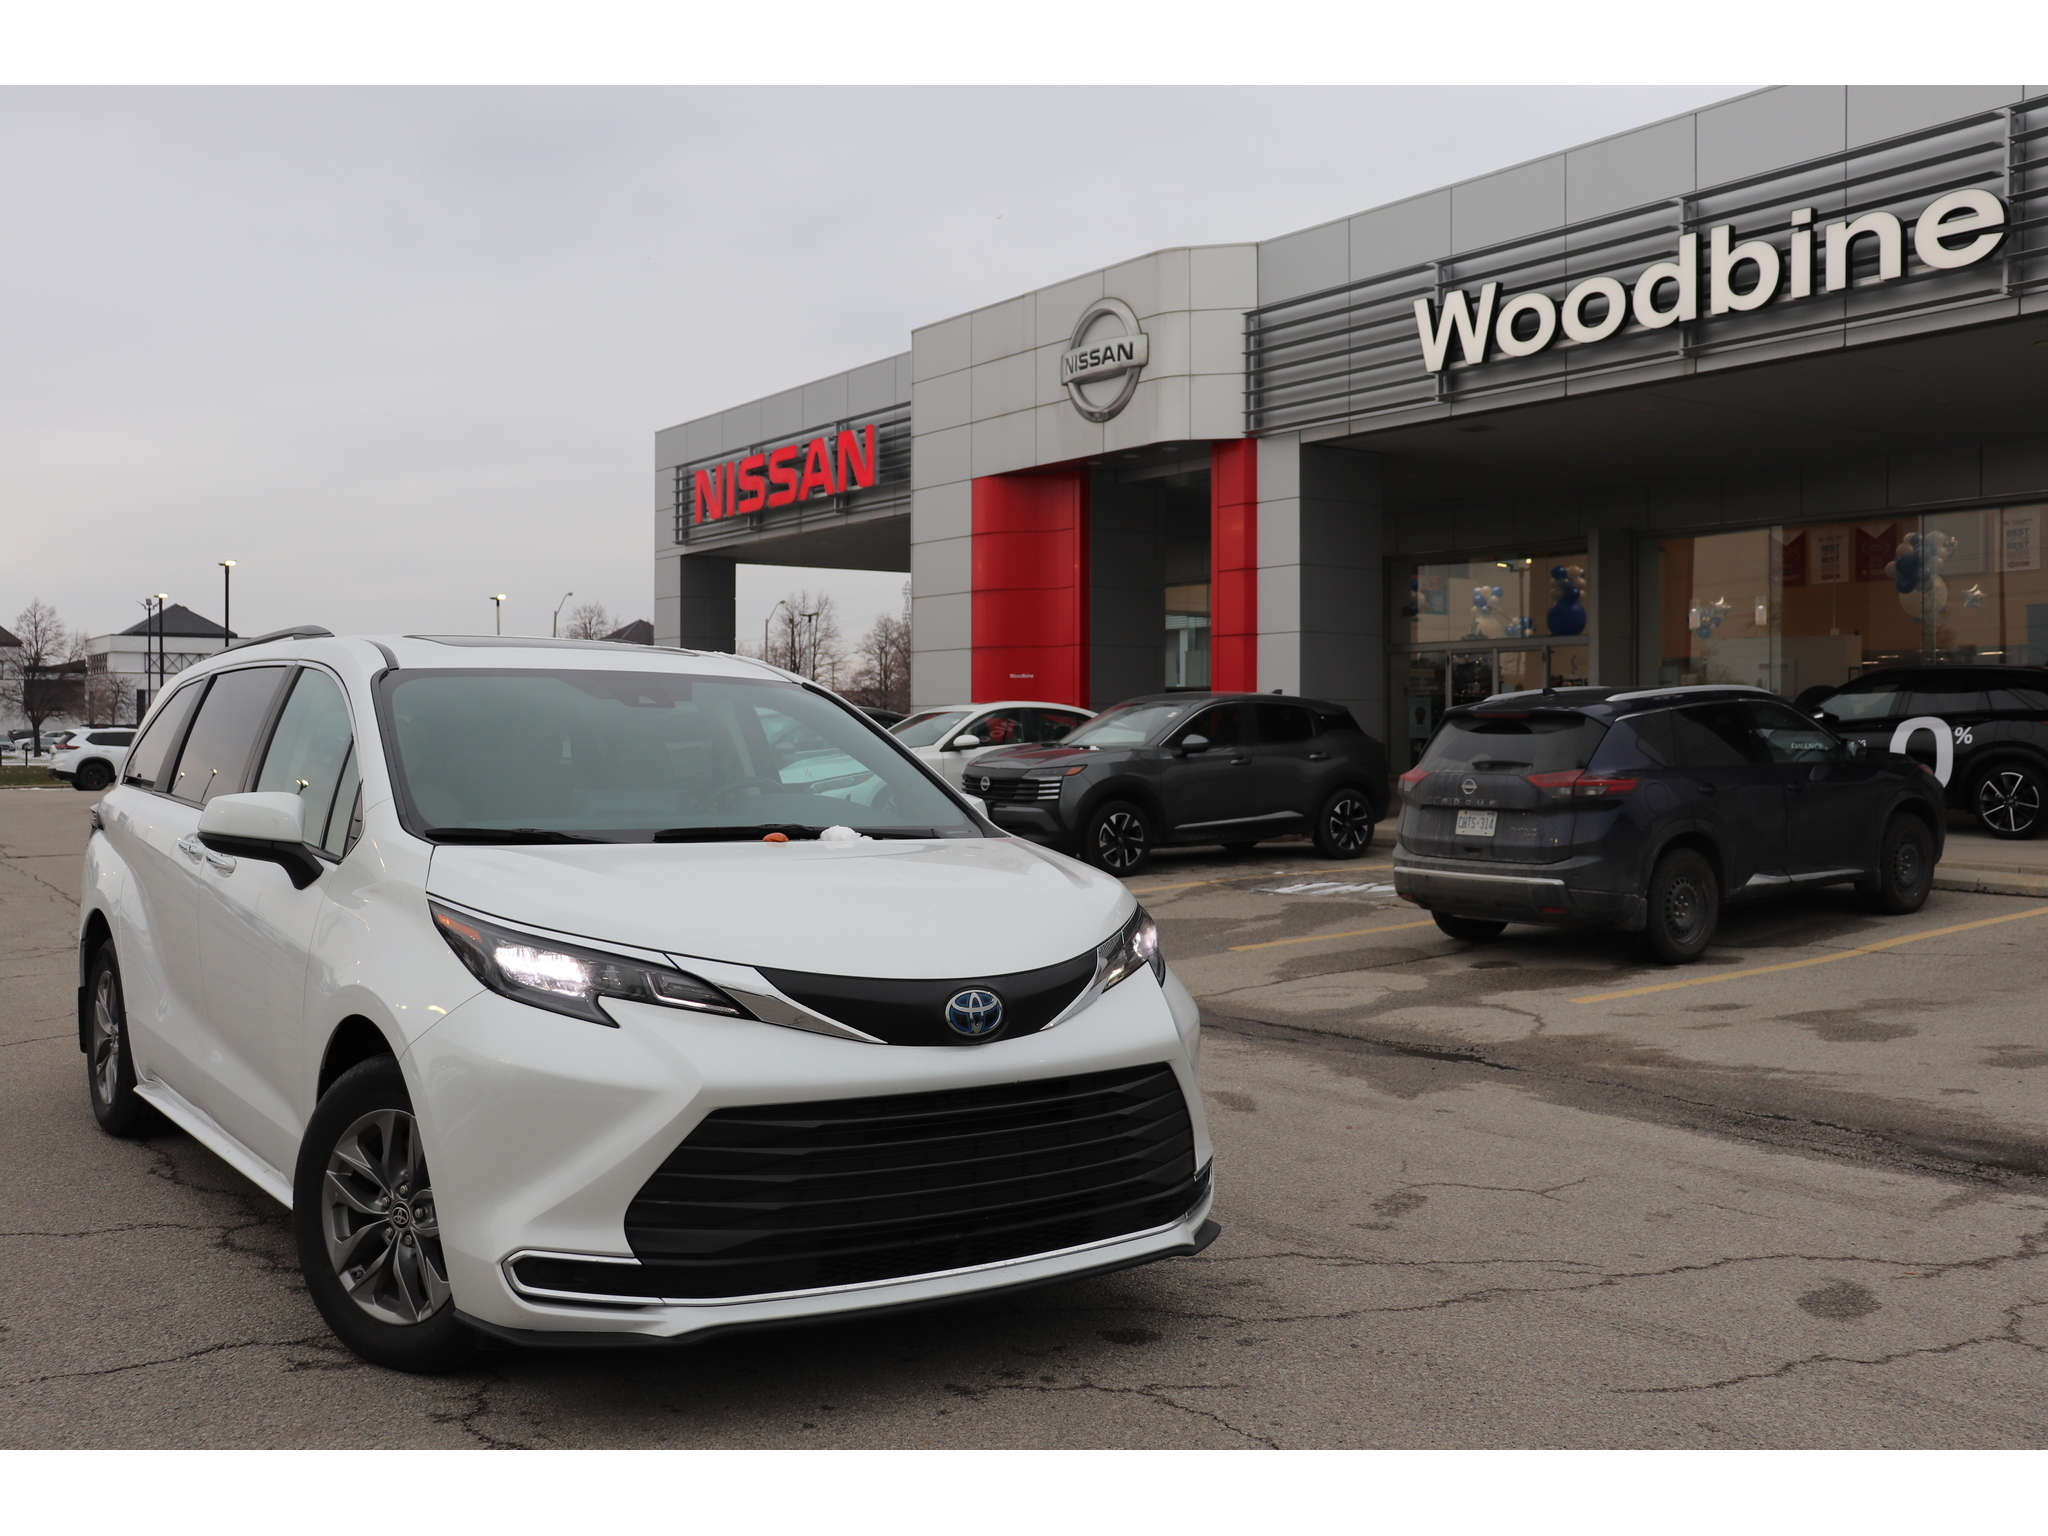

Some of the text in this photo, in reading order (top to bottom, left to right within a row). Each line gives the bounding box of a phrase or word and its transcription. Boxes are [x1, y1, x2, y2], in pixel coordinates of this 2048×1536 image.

[1413, 187, 2006, 373] Woodbine
[1064, 341, 1134, 376] NISSAN
[694, 424, 876, 524] NISSAN
[2006, 528, 2030, 537] BEST
[1821, 543, 1840, 552] BEST
[2006, 541, 2030, 550] BEST
[1821, 555, 1840, 564] BEST
[1441, 798, 1496, 806] ROGUE
